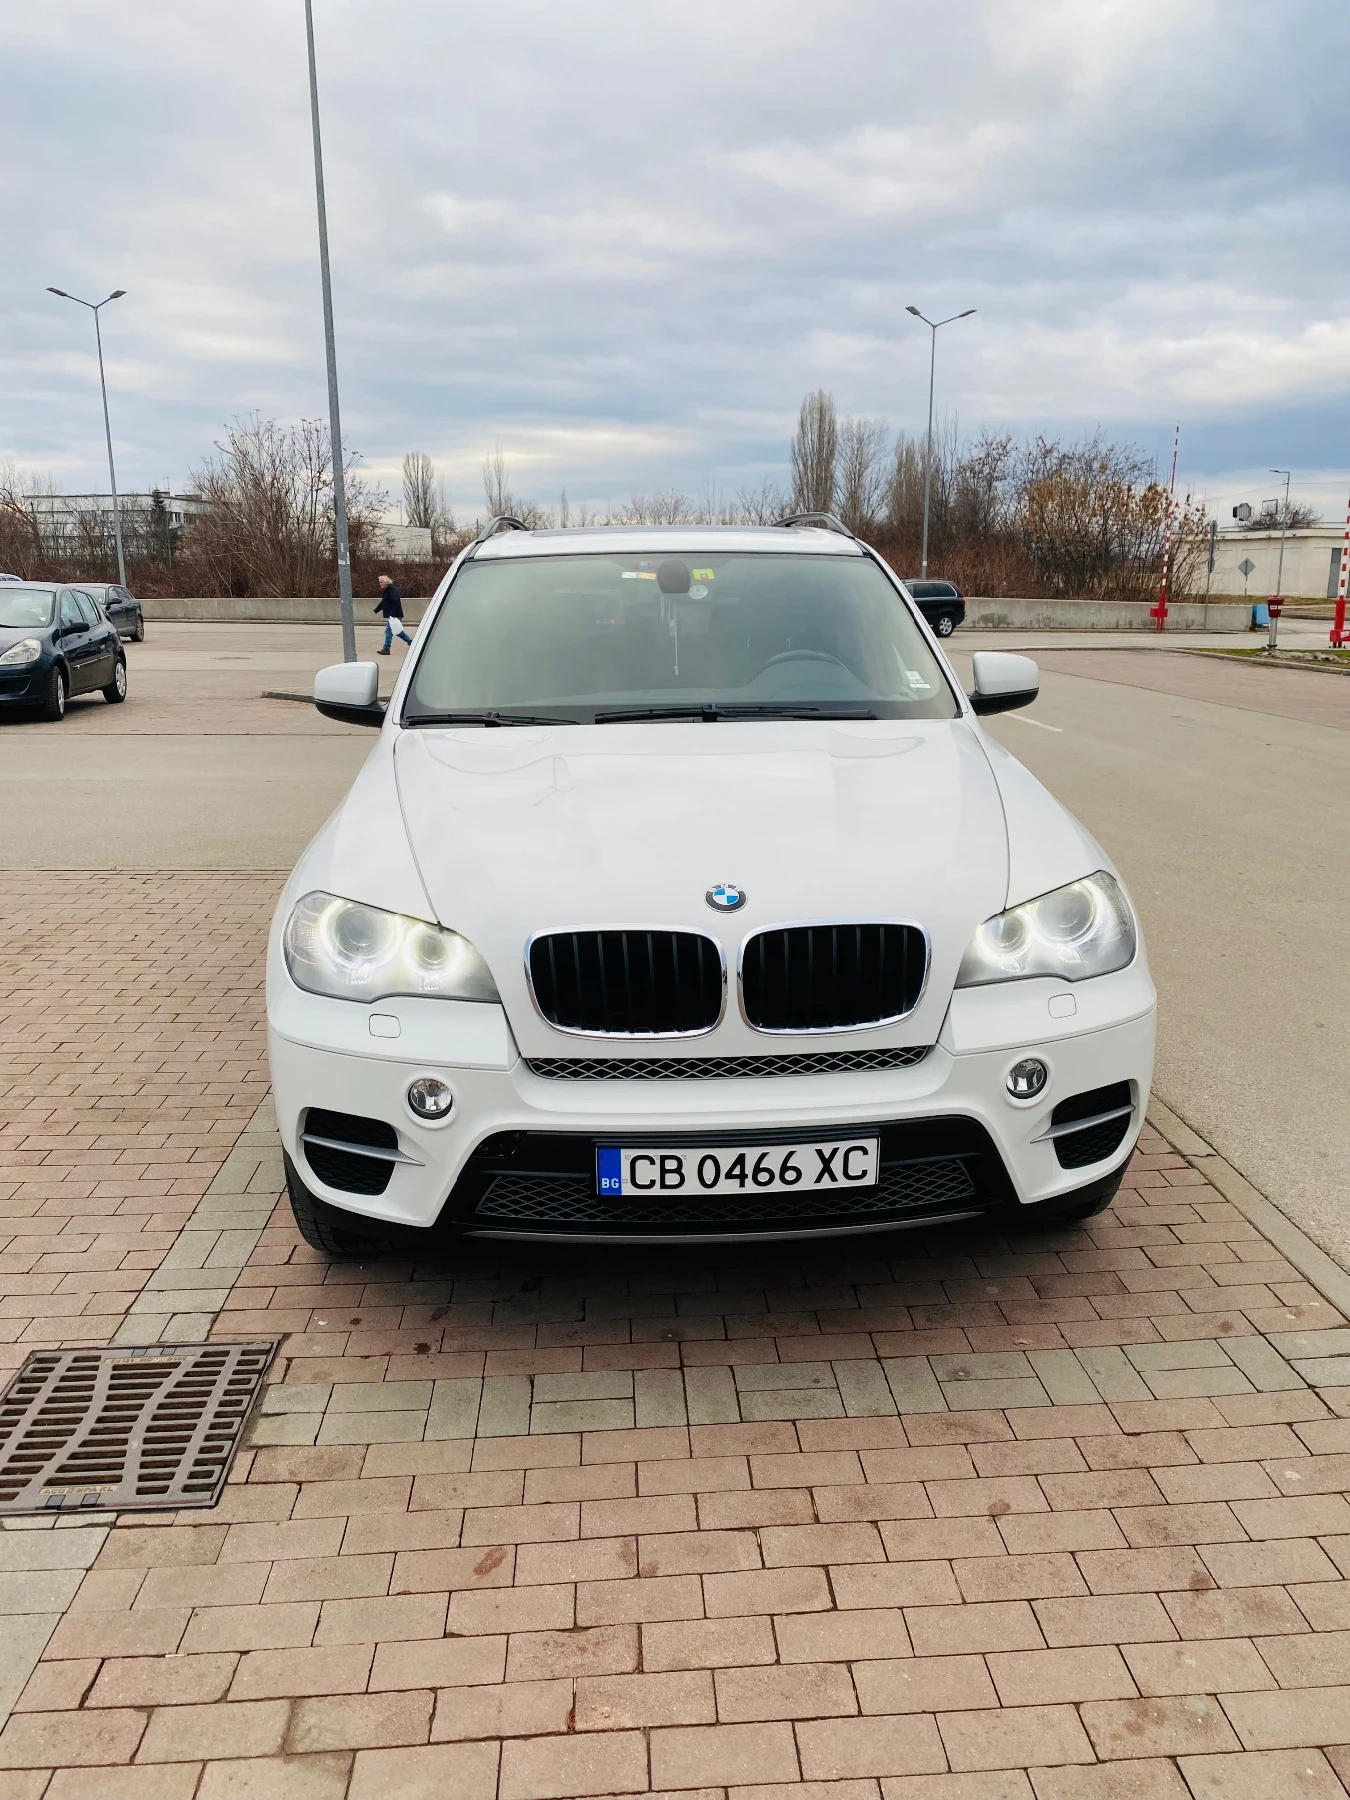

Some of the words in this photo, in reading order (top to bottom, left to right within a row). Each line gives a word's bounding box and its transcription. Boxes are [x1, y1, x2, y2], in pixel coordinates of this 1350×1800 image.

[629, 1154, 686, 1190] CB
[697, 1150, 803, 1189] 0466
[813, 1145, 869, 1185] XC
[601, 1177, 620, 1188] BG
